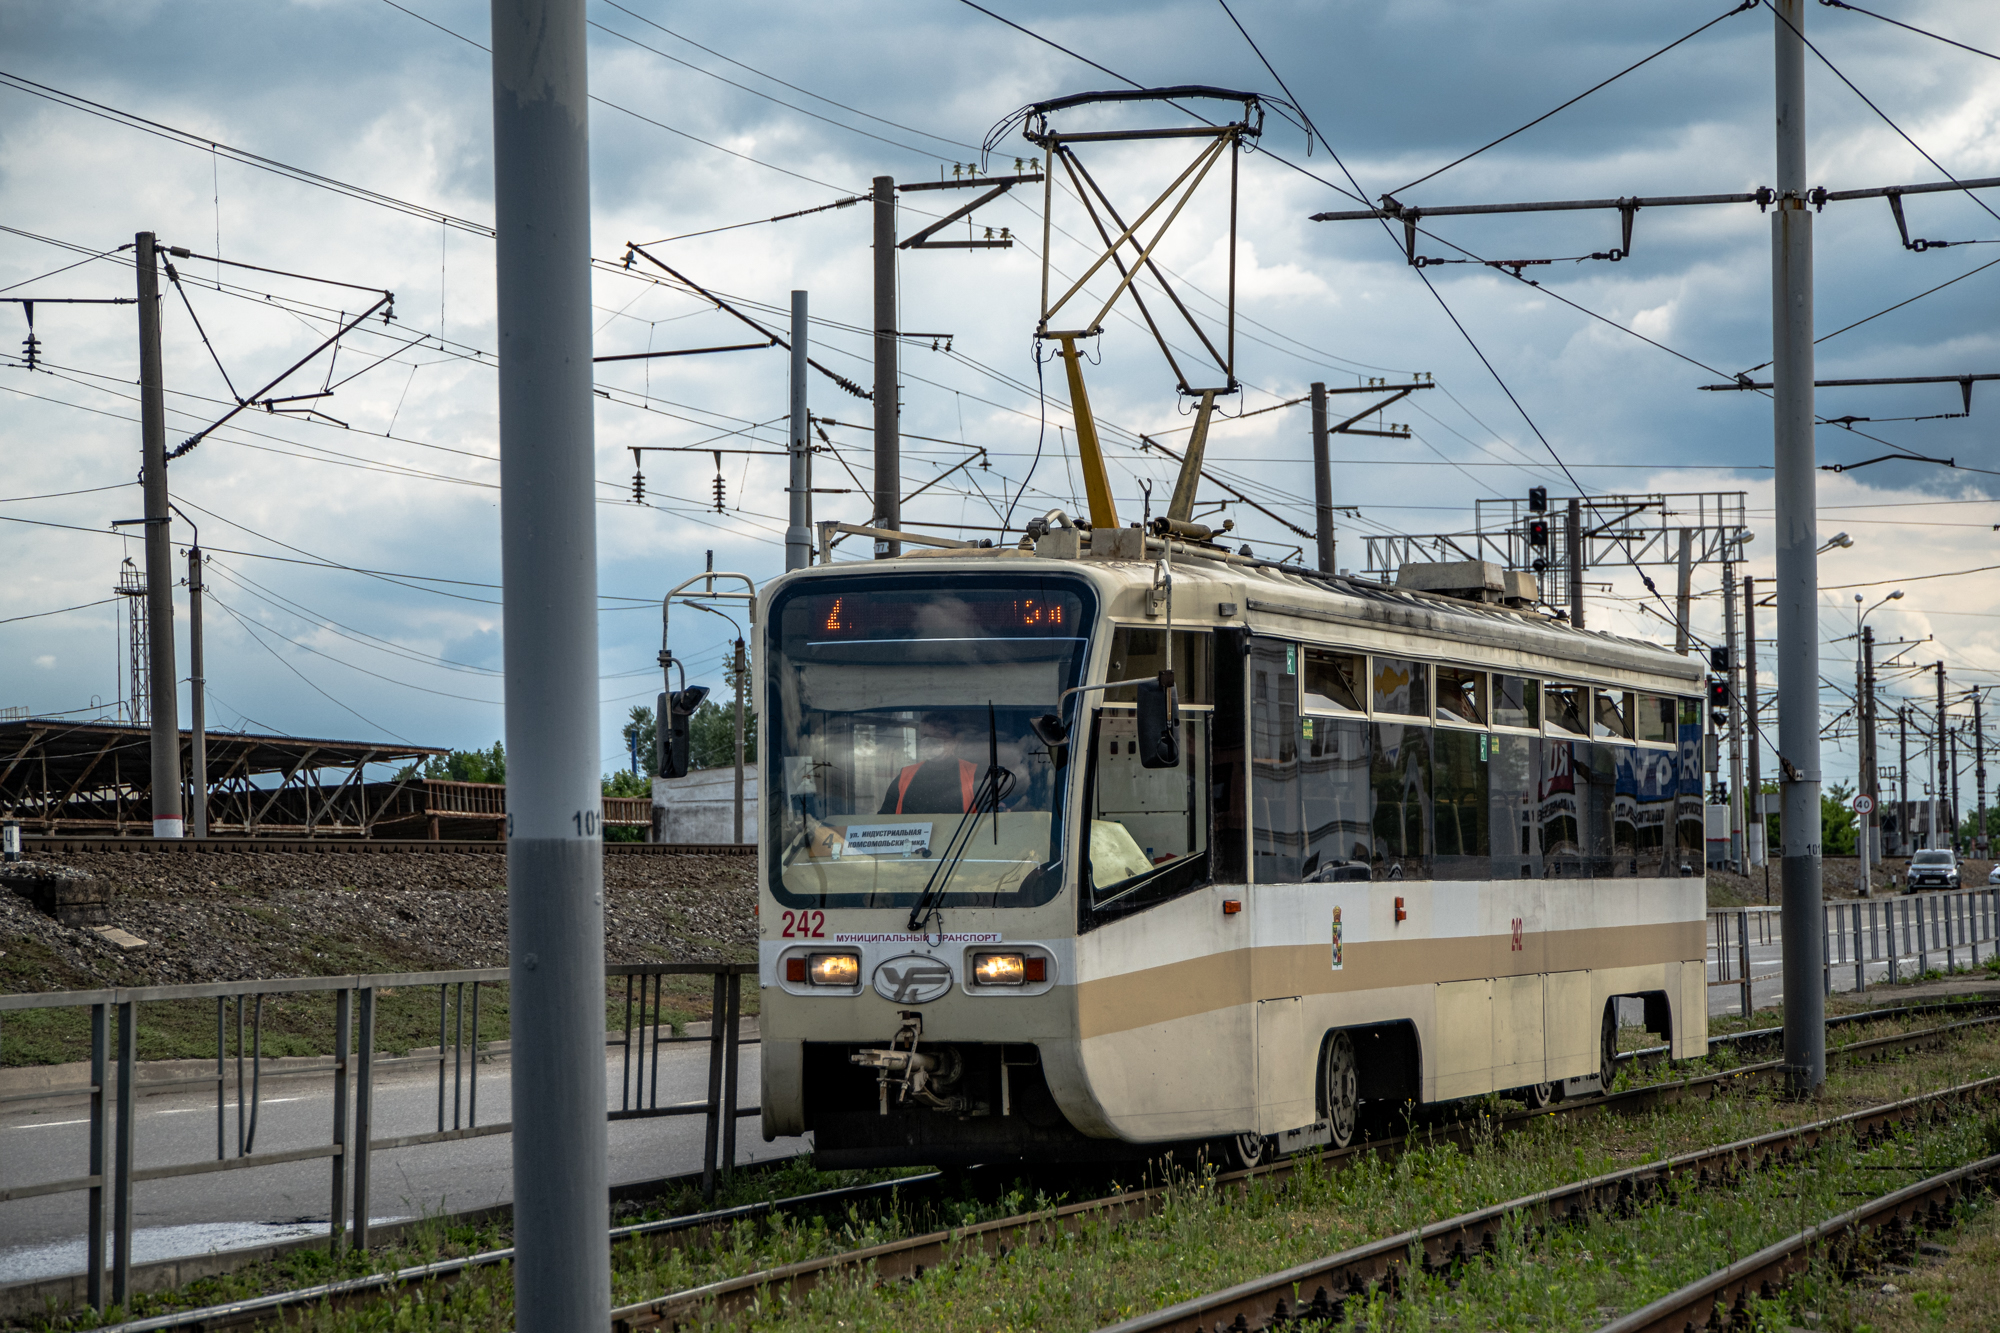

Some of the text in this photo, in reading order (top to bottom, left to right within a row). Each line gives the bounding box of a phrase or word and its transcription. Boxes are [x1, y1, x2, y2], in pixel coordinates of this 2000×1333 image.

[1856, 800, 1870, 809] 40
[861, 829, 922, 838] ИНДУСТРИАЛЬНАЯ
[822, 833, 834, 848] 4
[848, 839, 909, 848] КОМСОМОЛЬСКИ
[782, 910, 825, 938] 242
[836, 933, 997, 943] МУНИЦИПАЛЬНЫЙ ТРАНСПОРТ
[1511, 917, 1523, 951] 242
